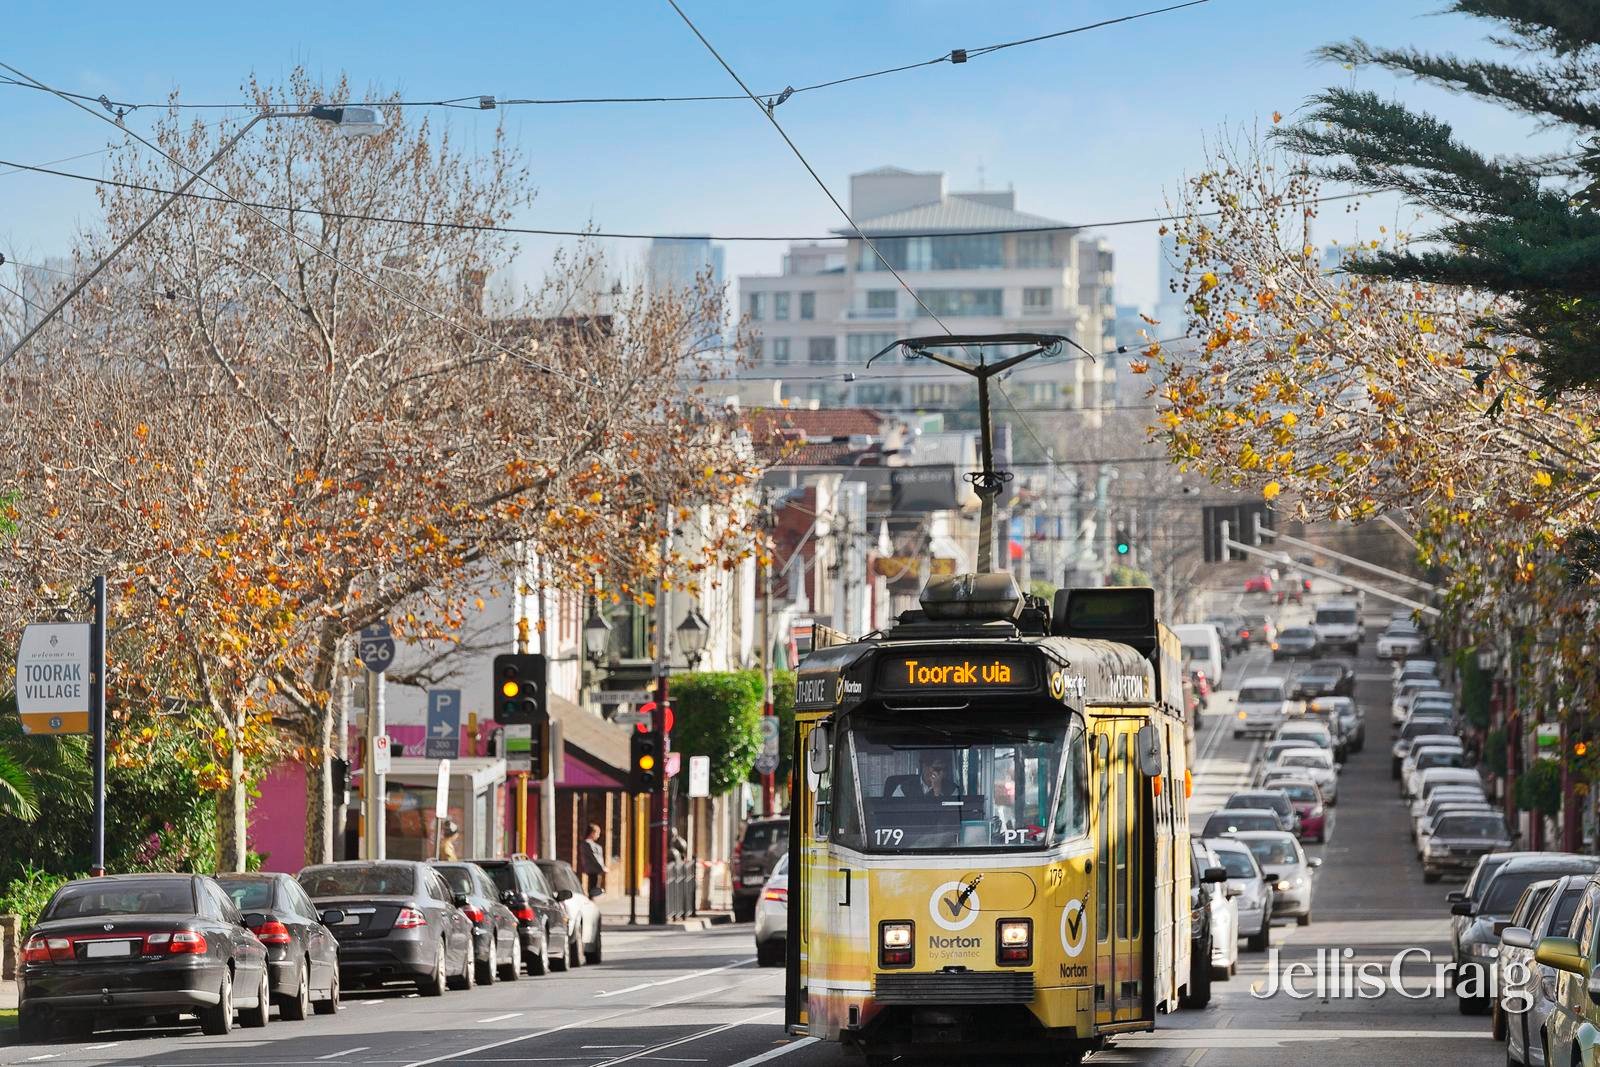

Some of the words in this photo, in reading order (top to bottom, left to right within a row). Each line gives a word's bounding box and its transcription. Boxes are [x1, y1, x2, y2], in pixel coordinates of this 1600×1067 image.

[31, 651, 64, 659] welcome
[364, 643, 390, 662] 26
[25, 664, 81, 682] TOORAK
[905, 661, 978, 683] Toorak
[982, 661, 1011, 683] via
[25, 684, 80, 699] VILLAGE
[844, 680, 862, 693] Norton
[1110, 675, 1143, 698] NORTON
[436, 694, 452, 713] P
[874, 828, 904, 845] 179
[1050, 868, 1063, 887] 179
[929, 935, 981, 949] Norton
[929, 951, 939, 959] by
[941, 950, 980, 959] Symantec
[1059, 963, 1088, 979] Norton
